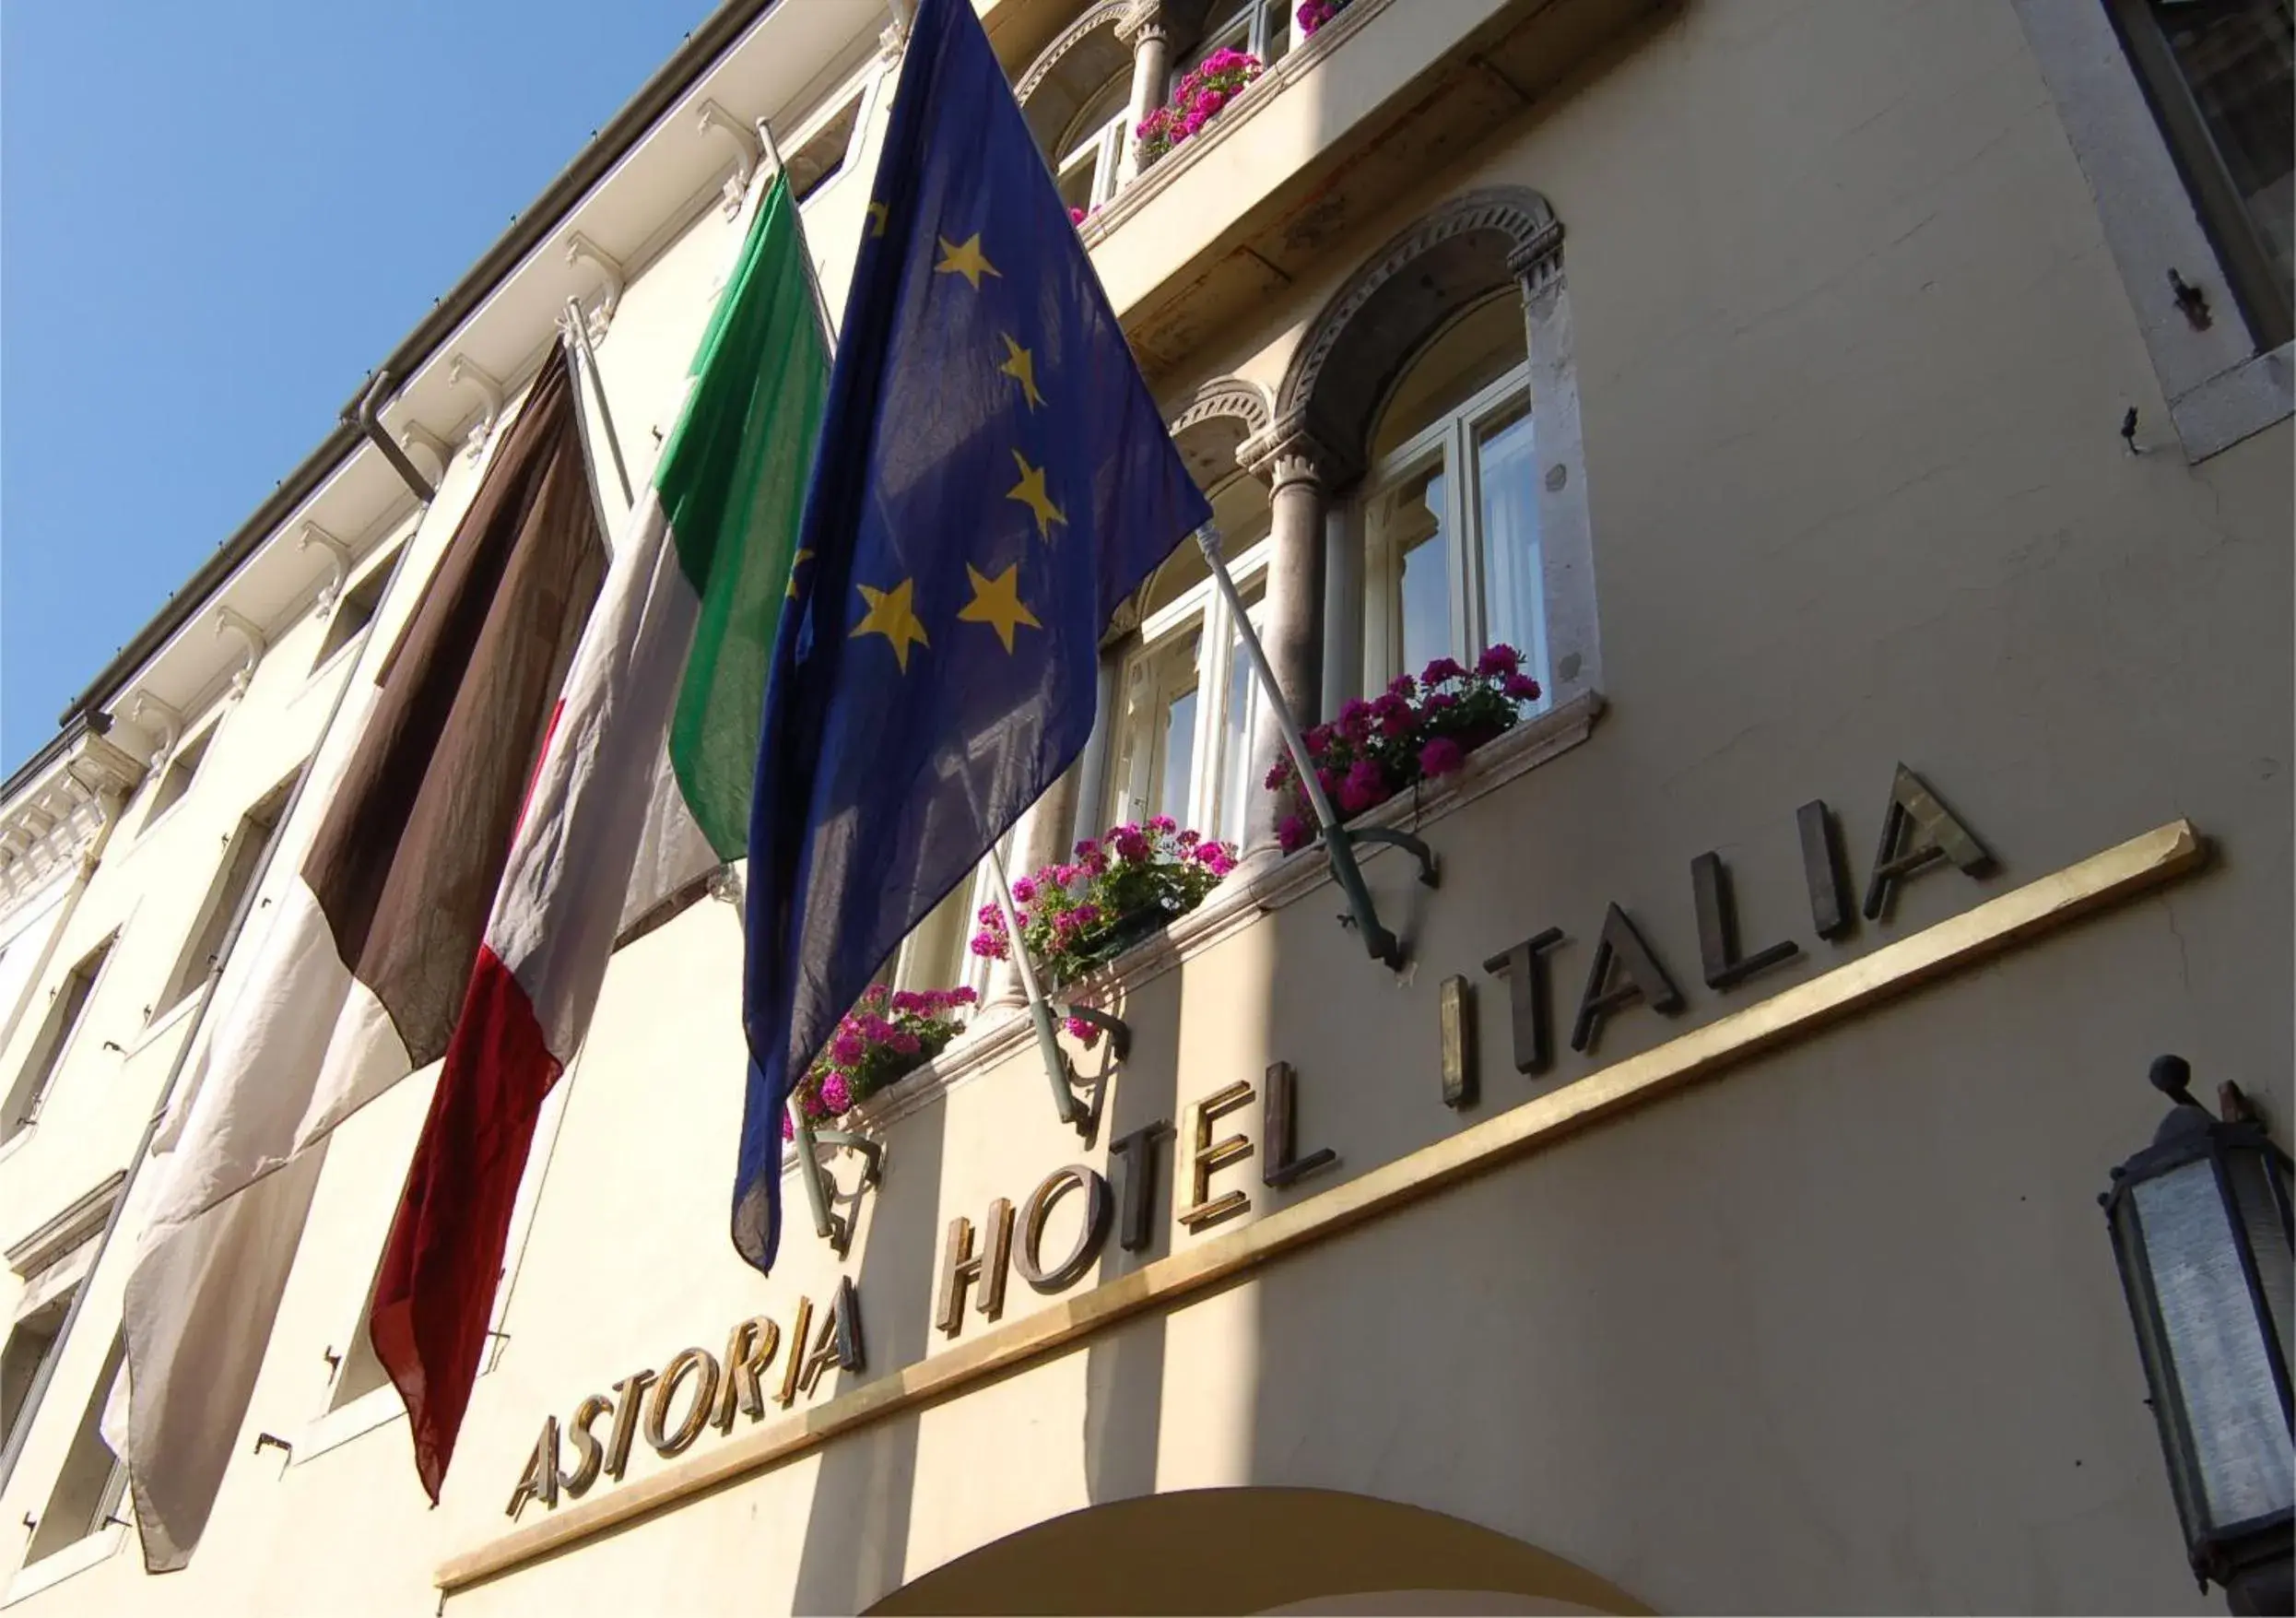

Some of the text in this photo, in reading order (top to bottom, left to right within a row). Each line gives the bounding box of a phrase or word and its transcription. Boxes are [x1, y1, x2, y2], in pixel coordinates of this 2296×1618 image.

[505, 761, 1996, 1517] ASTORIA HOTEL ITALIA
